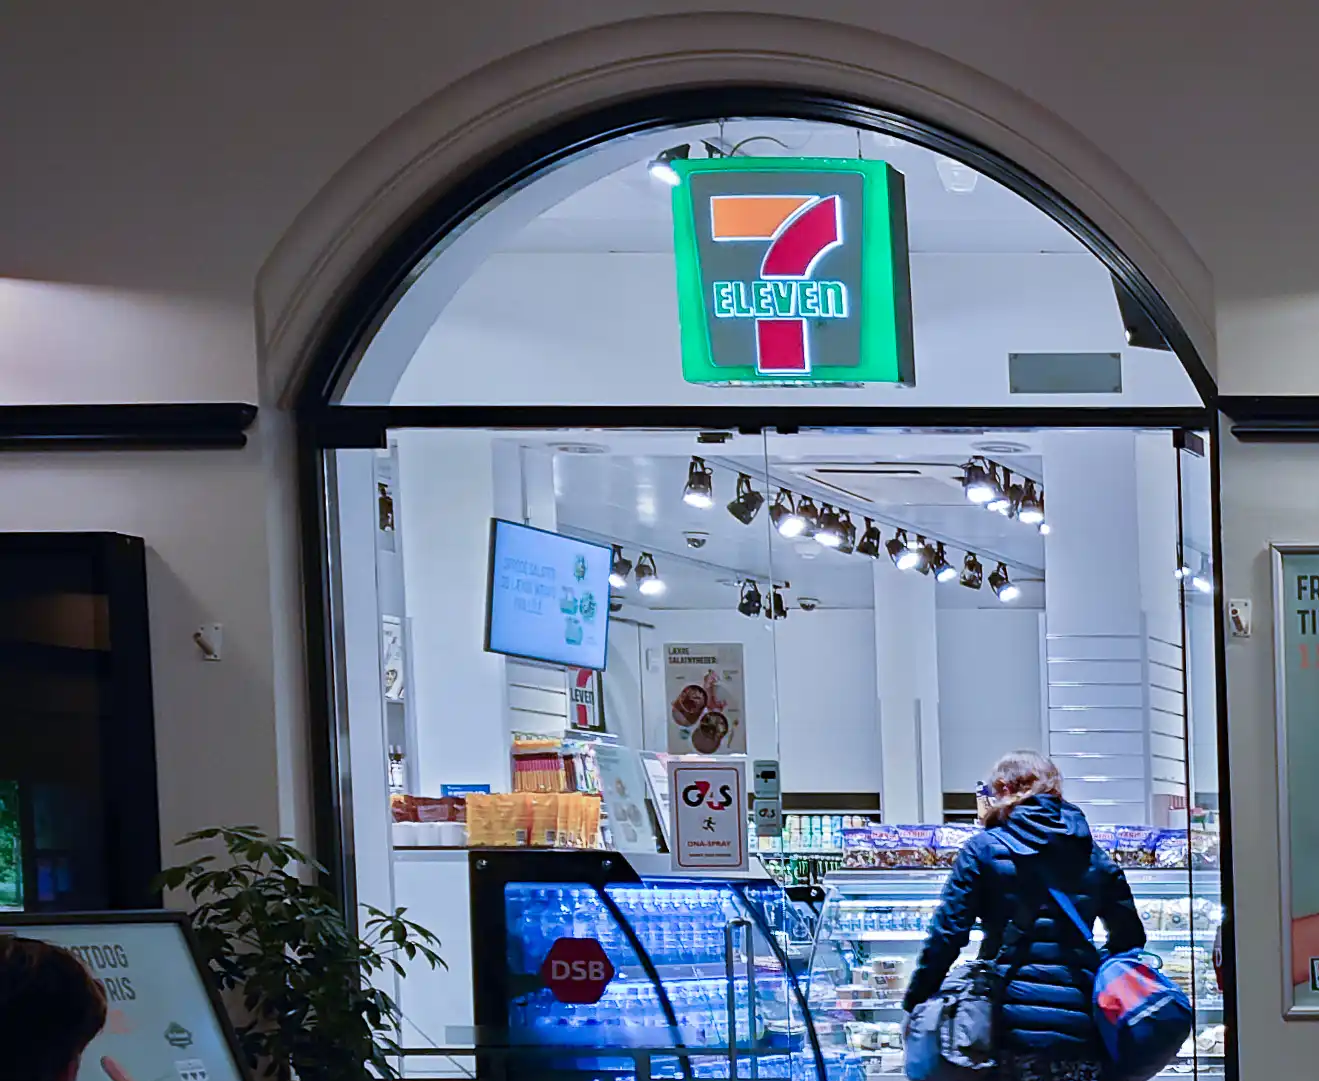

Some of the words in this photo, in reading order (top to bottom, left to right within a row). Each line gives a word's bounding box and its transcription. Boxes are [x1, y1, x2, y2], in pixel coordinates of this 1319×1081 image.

[64, 944, 129, 970] OTDOG
[551, 960, 605, 981] DSB
[103, 976, 136, 1001] RIS
